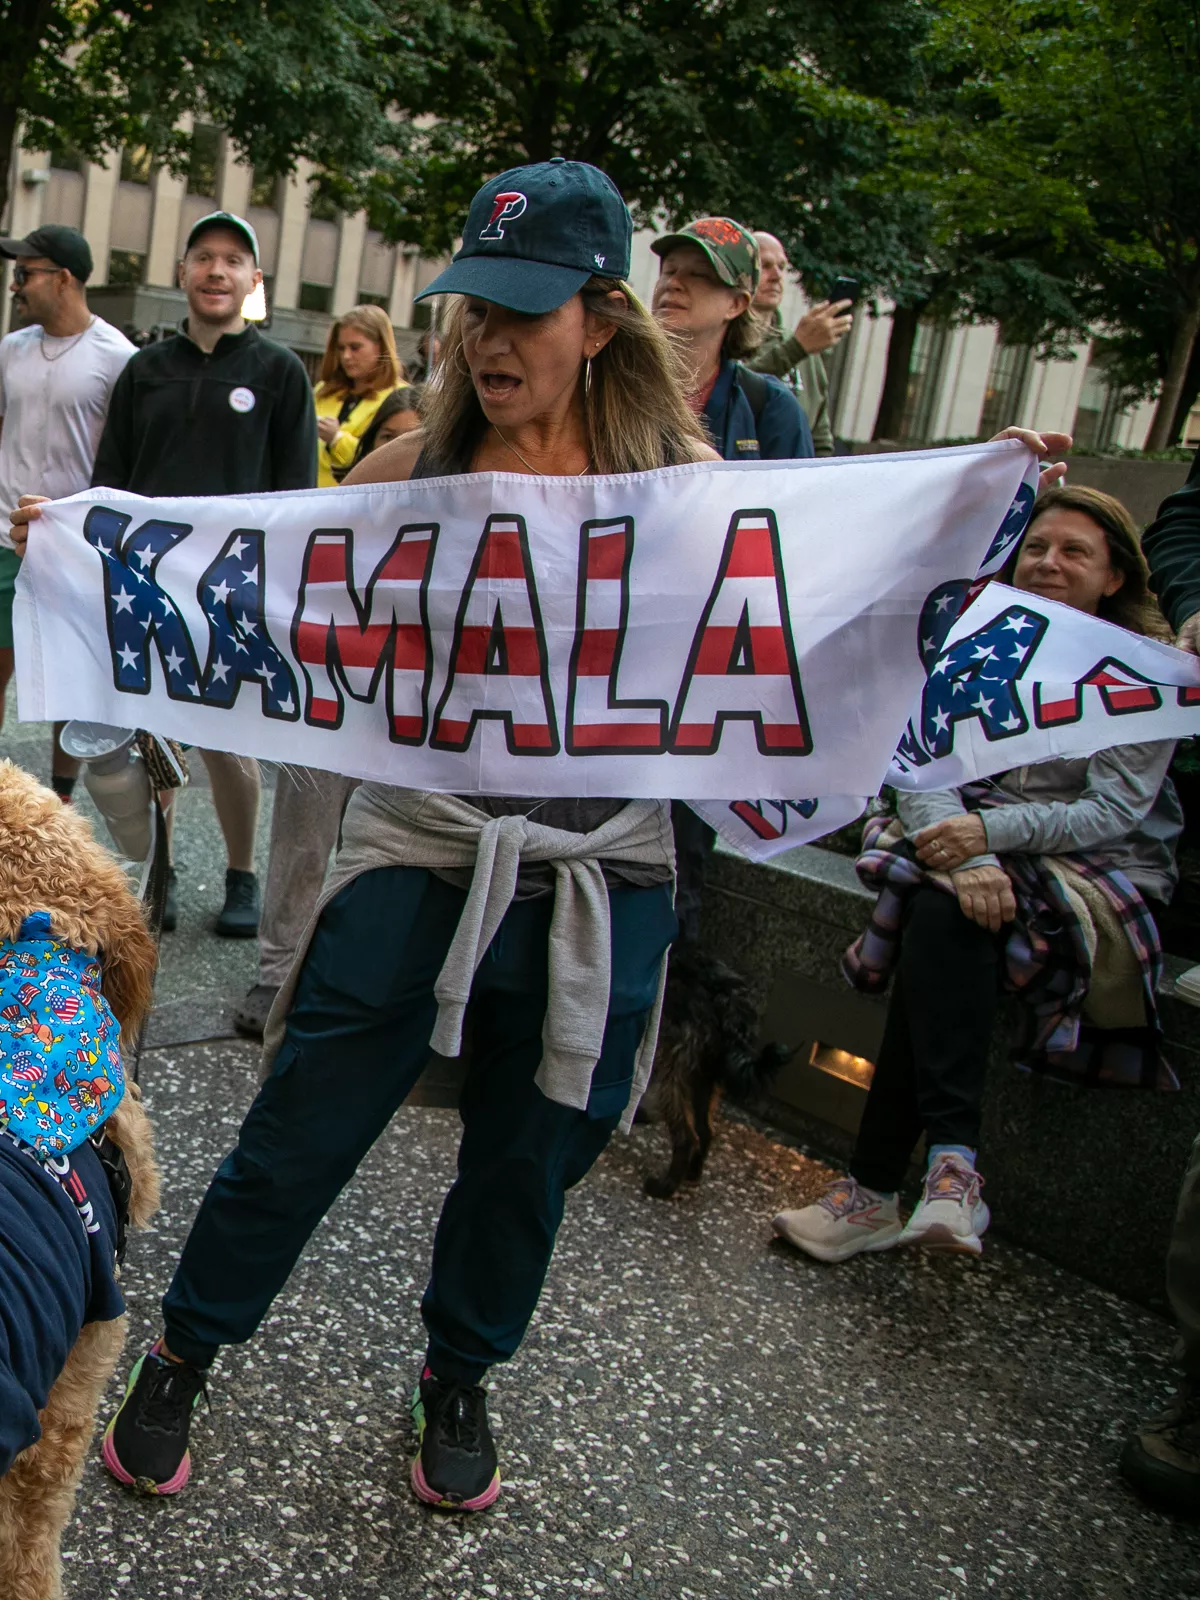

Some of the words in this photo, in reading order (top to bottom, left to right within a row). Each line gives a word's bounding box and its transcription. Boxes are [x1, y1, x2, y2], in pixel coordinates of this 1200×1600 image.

[479, 191, 528, 240] P
[83, 505, 814, 757] KAMALA
[47, 966, 78, 981] MERICA
